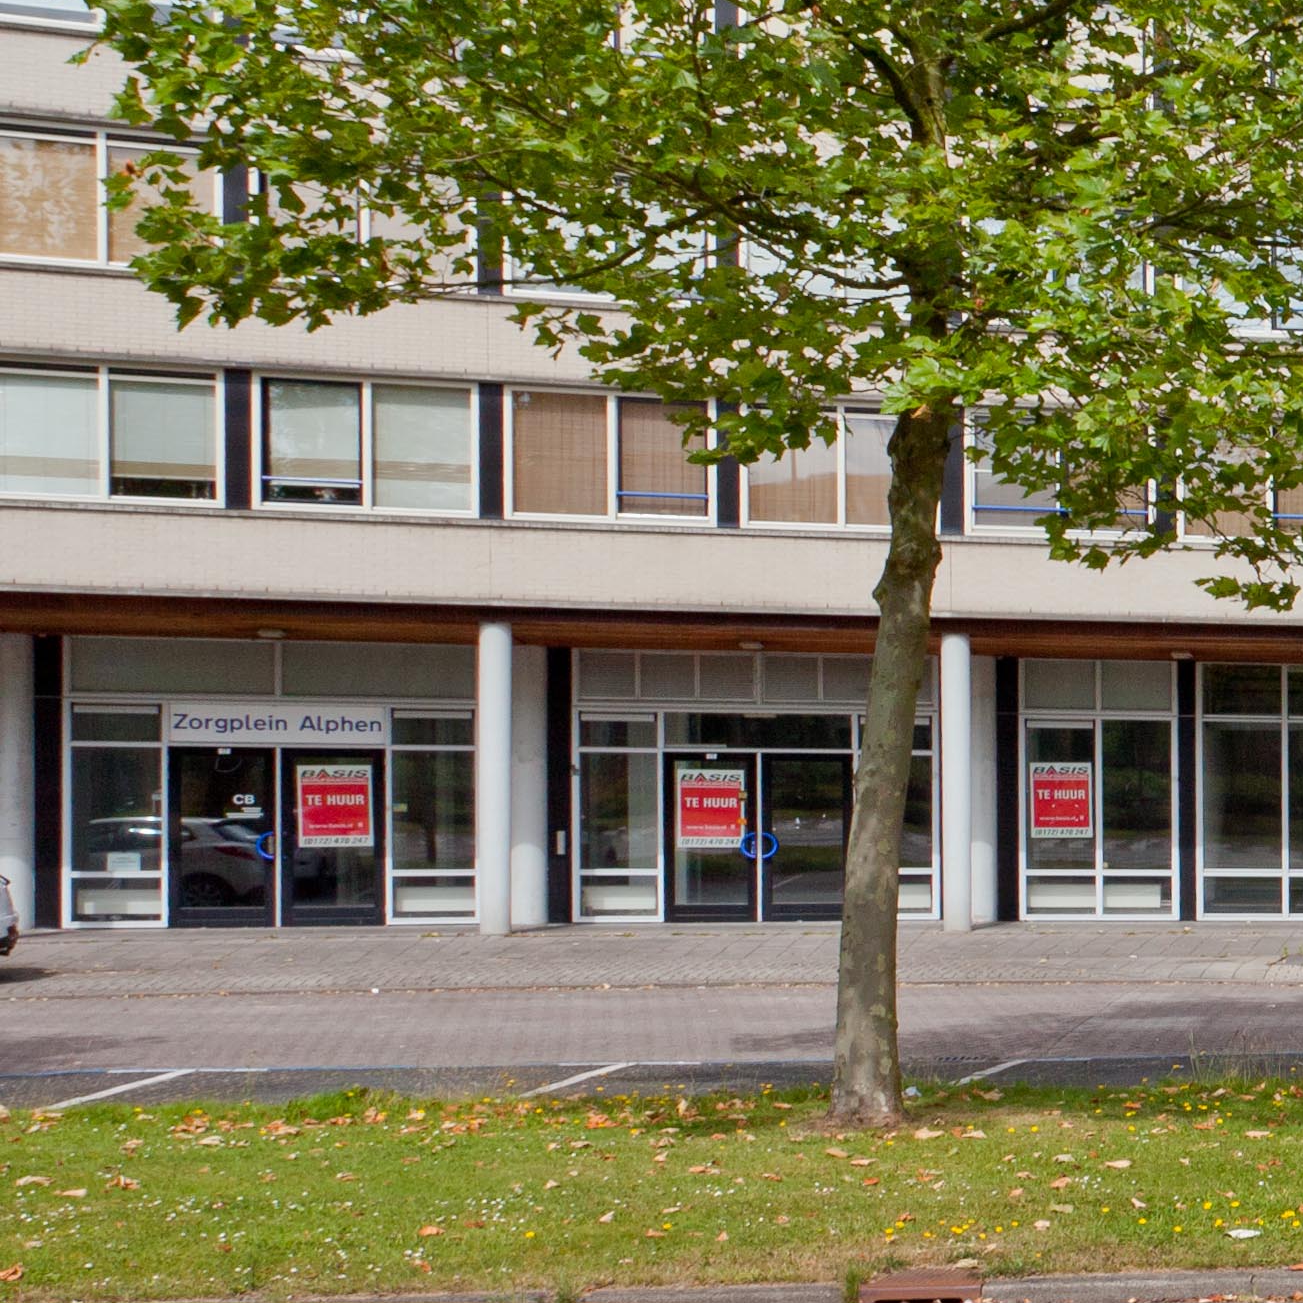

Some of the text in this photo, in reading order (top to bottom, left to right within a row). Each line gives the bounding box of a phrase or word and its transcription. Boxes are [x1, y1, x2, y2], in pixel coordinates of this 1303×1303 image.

[172, 713, 383, 735] Zorgplein Alphen
[301, 768, 369, 779] BASIS
[1034, 766, 1089, 775] BASIS
[681, 773, 741, 782] BASIS
[232, 794, 256, 806] CB
[1037, 789, 1086, 800] TE HUUR
[305, 794, 365, 807] TE HUUR
[684, 797, 738, 809] TE HUUR
